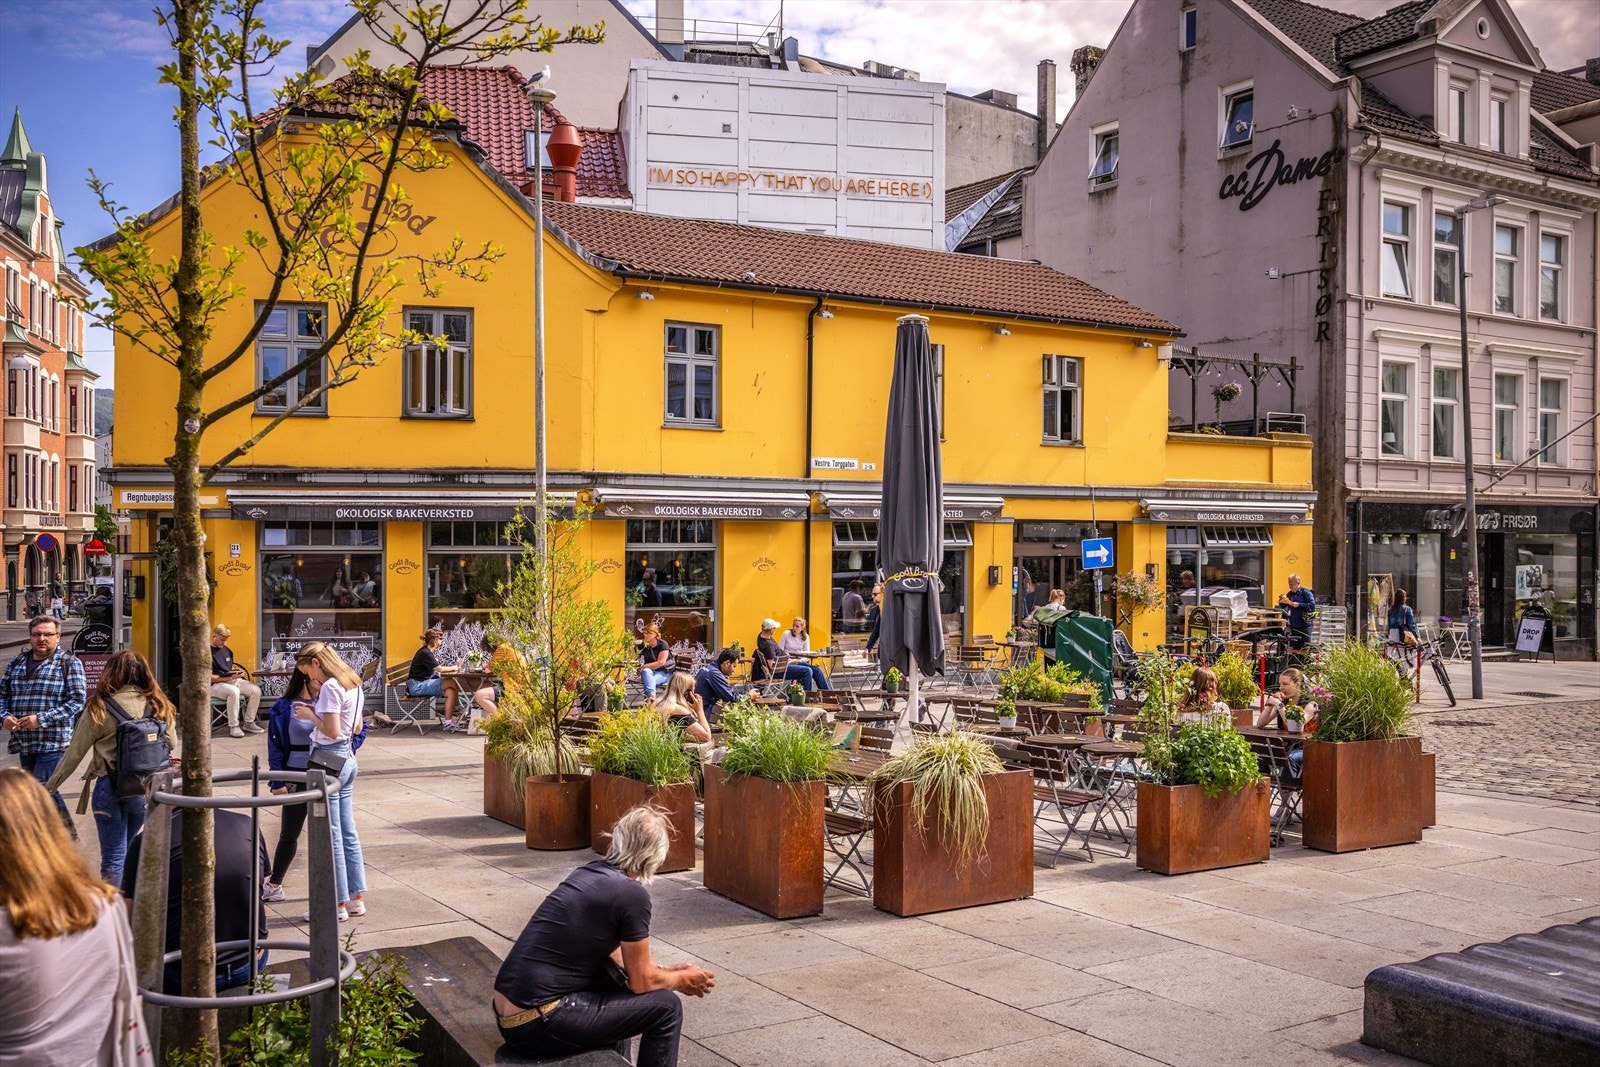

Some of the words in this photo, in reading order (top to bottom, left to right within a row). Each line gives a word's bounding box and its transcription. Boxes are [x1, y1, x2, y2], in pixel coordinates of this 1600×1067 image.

[649, 168, 674, 184] I'M
[676, 169, 698, 185] SO
[701, 171, 760, 188] HAPPY
[763, 173, 807, 190] THAT
[809, 176, 842, 192] YOU
[845, 178, 876, 195] ARE
[878, 181, 919, 197] HERE
[1314, 188, 1332, 344] FRISØR
[814, 459, 831, 468] Vestre
[832, 459, 855, 470] Torggaten
[335, 508, 394, 518] ØKOLOGISK
[396, 508, 474, 518] BAKEVERKSTED
[654, 505, 700, 516] ØKOLOGISK
[702, 507, 762, 516] BAKEVERKSTED
[1197, 513, 1226, 521] ØKOLOGISK
[1502, 514, 1538, 529] FRISØR
[218, 560, 234, 572] Godt
[388, 558, 403, 570] Godt
[893, 566, 913, 581] Godt
[286, 641, 302, 650] Spis
